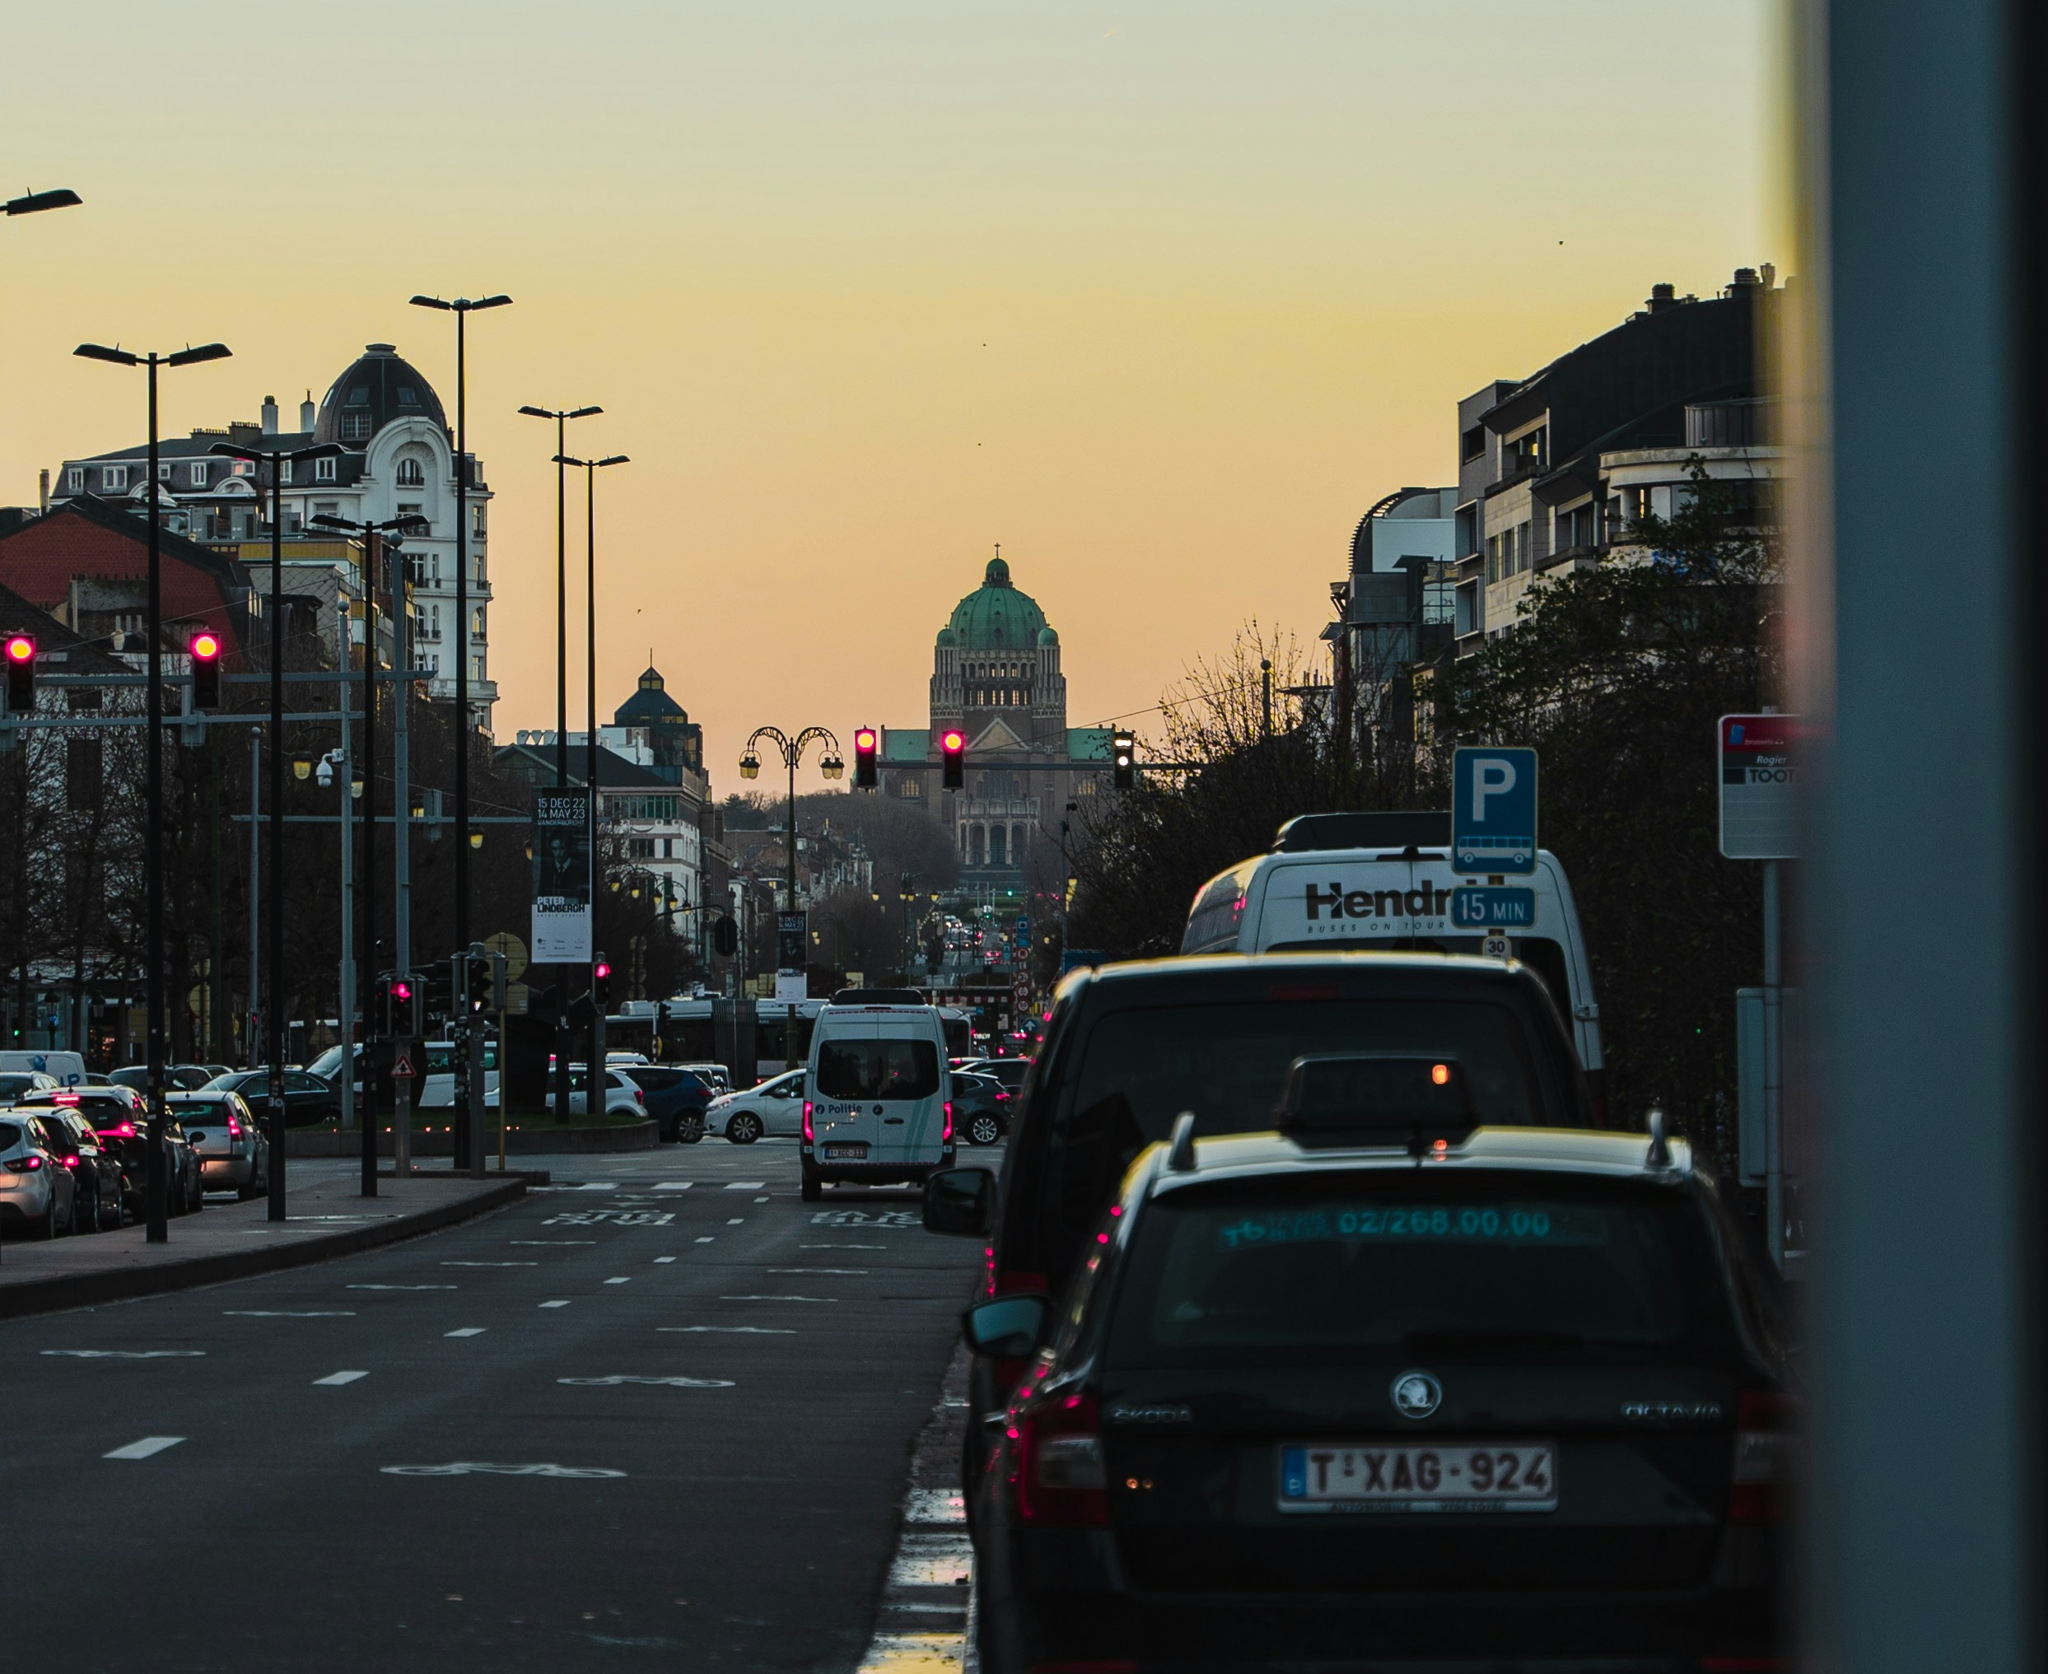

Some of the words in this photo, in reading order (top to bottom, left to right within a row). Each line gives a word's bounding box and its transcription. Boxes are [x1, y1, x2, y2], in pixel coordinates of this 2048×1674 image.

[1756, 755, 1787, 766] Rogier
[1750, 769, 1799, 783] TOOT
[1472, 758, 1517, 822] P
[537, 797, 548, 809] 15
[550, 797, 570, 809] DEC
[572, 797, 585, 809] 22
[537, 809, 548, 819] 14
[549, 809, 571, 819] MAY
[572, 809, 585, 819] 23
[536, 896, 565, 904] PETER
[1306, 879, 1456, 920] Hendr
[537, 904, 585, 913] LINDBERGH
[1461, 893, 1486, 921] 15
[1308, 924, 1357, 933] BUSES
[1371, 923, 1391, 931] ON
[1403, 921, 1445, 930] TOUR
[1488, 941, 1505, 953] 30
[828, 1104, 862, 1114] Politie
[1337, 1209, 1551, 1238] 02/268.00.00
